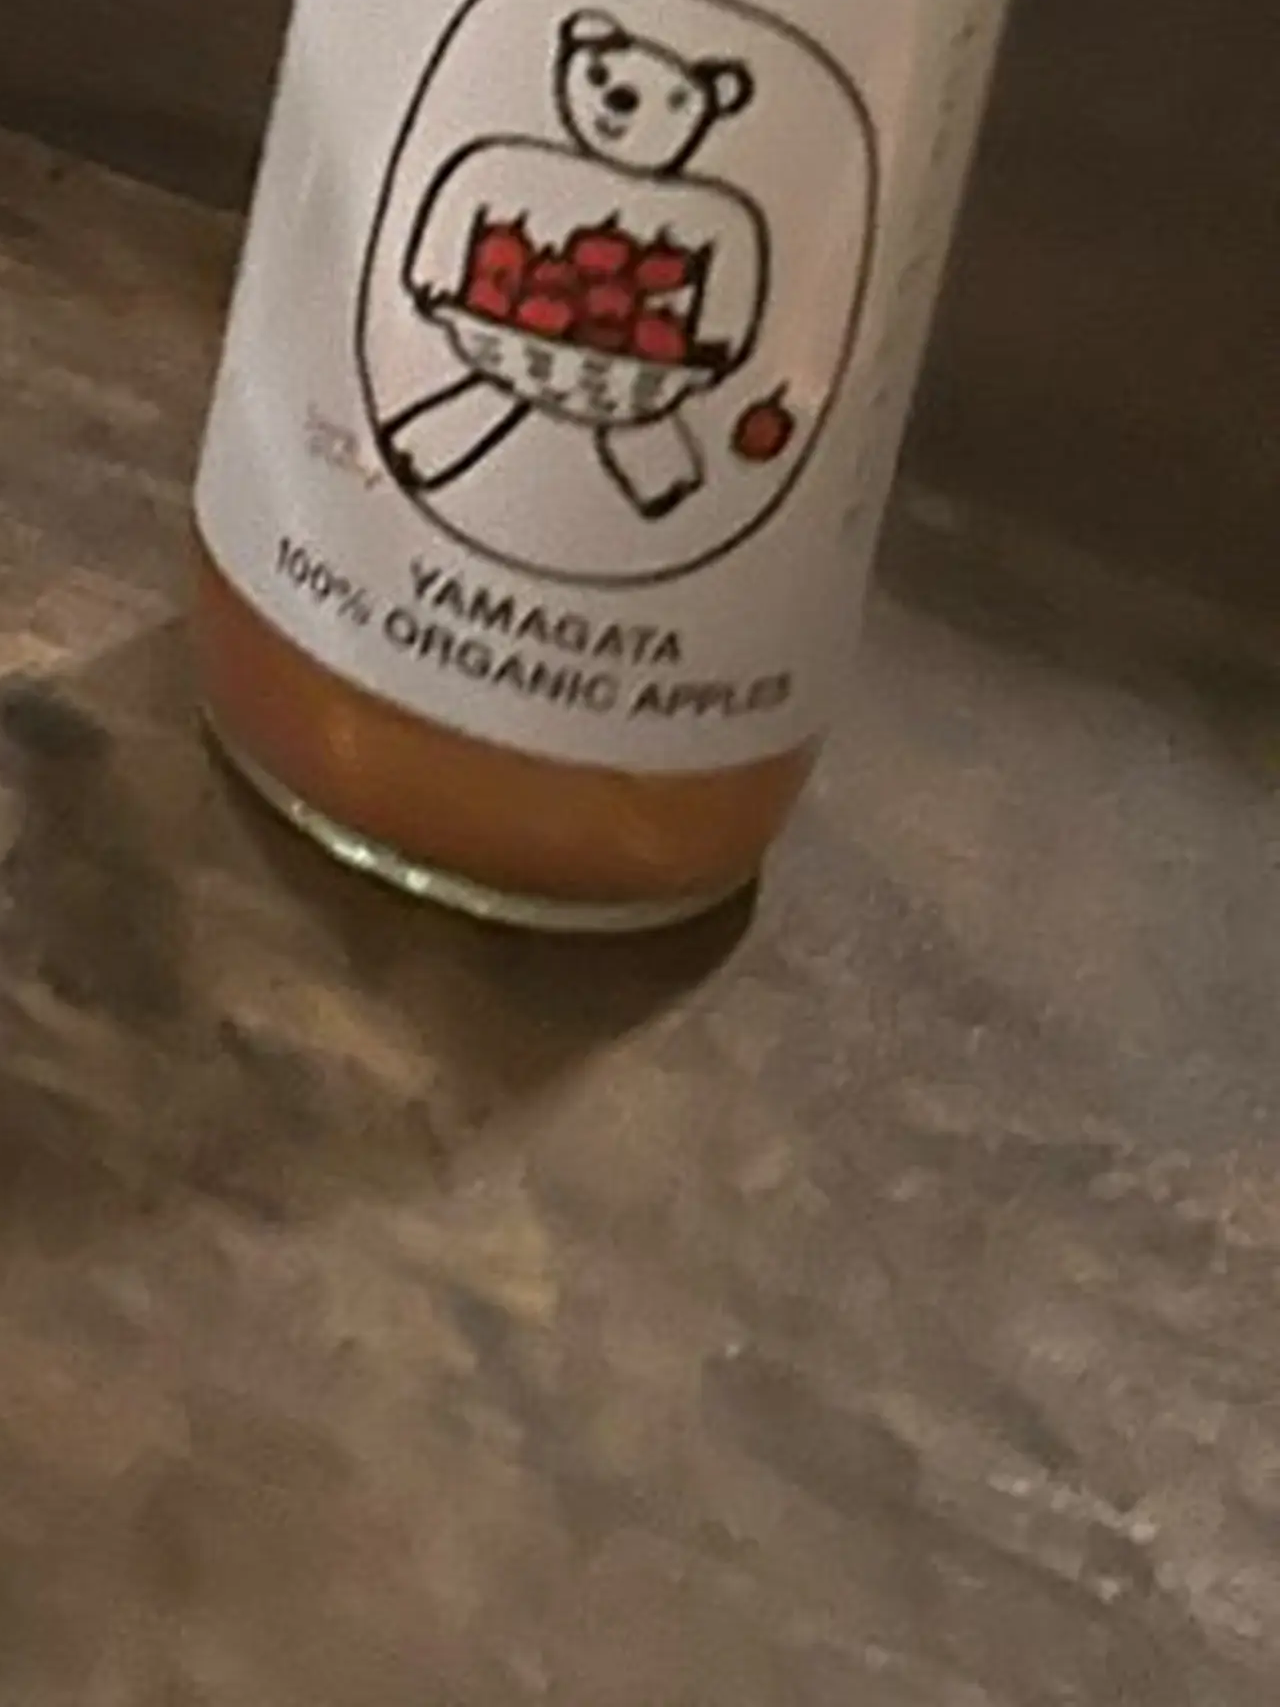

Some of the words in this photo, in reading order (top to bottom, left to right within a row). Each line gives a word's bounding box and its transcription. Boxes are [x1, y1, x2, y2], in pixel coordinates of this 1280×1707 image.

[275, 538, 373, 625] 100%
[384, 607, 618, 713] ORGANIC
[627, 672, 792, 719] APPLES
[410, 556, 681, 665] YAMAGATA
